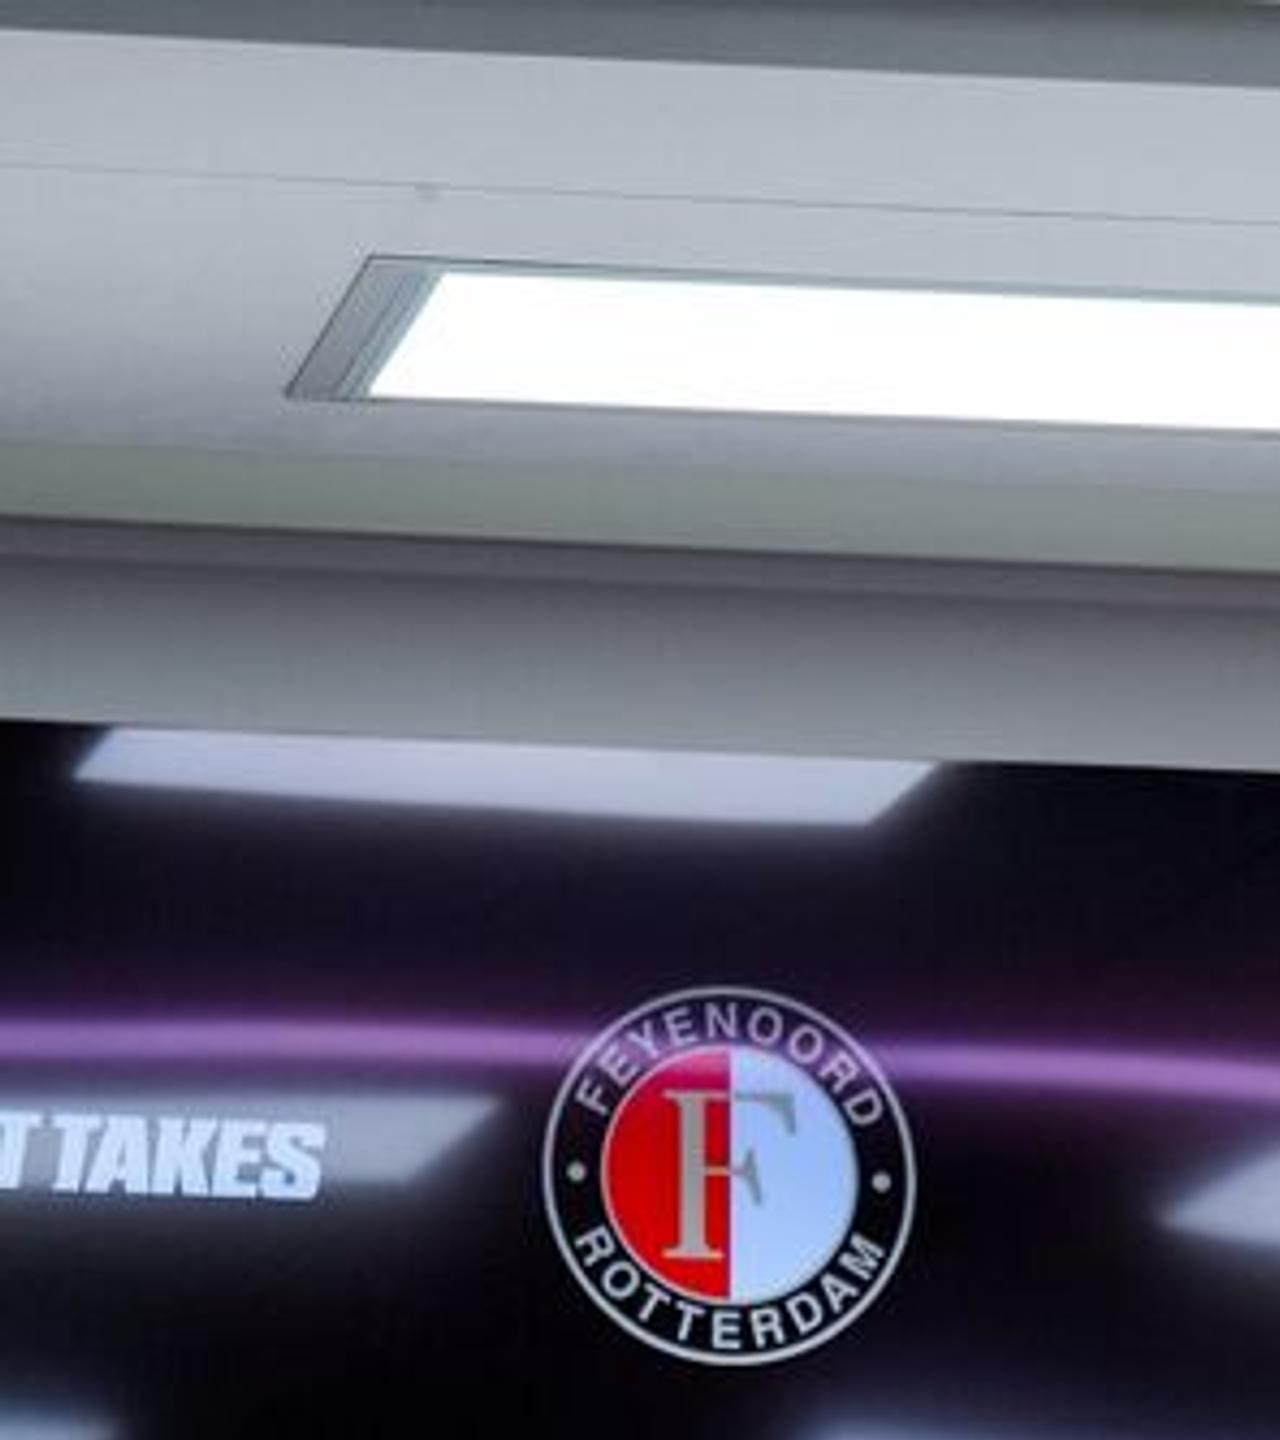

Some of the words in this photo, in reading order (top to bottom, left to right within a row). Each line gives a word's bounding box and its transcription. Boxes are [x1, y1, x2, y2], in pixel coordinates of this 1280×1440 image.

[577, 1003, 884, 1128] FEYENOORD
[0, 1112, 42, 1190] T
[52, 1114, 327, 1199] TAKES
[664, 1089, 797, 1260] F
[576, 1226, 887, 1350] ROTTERDAM
